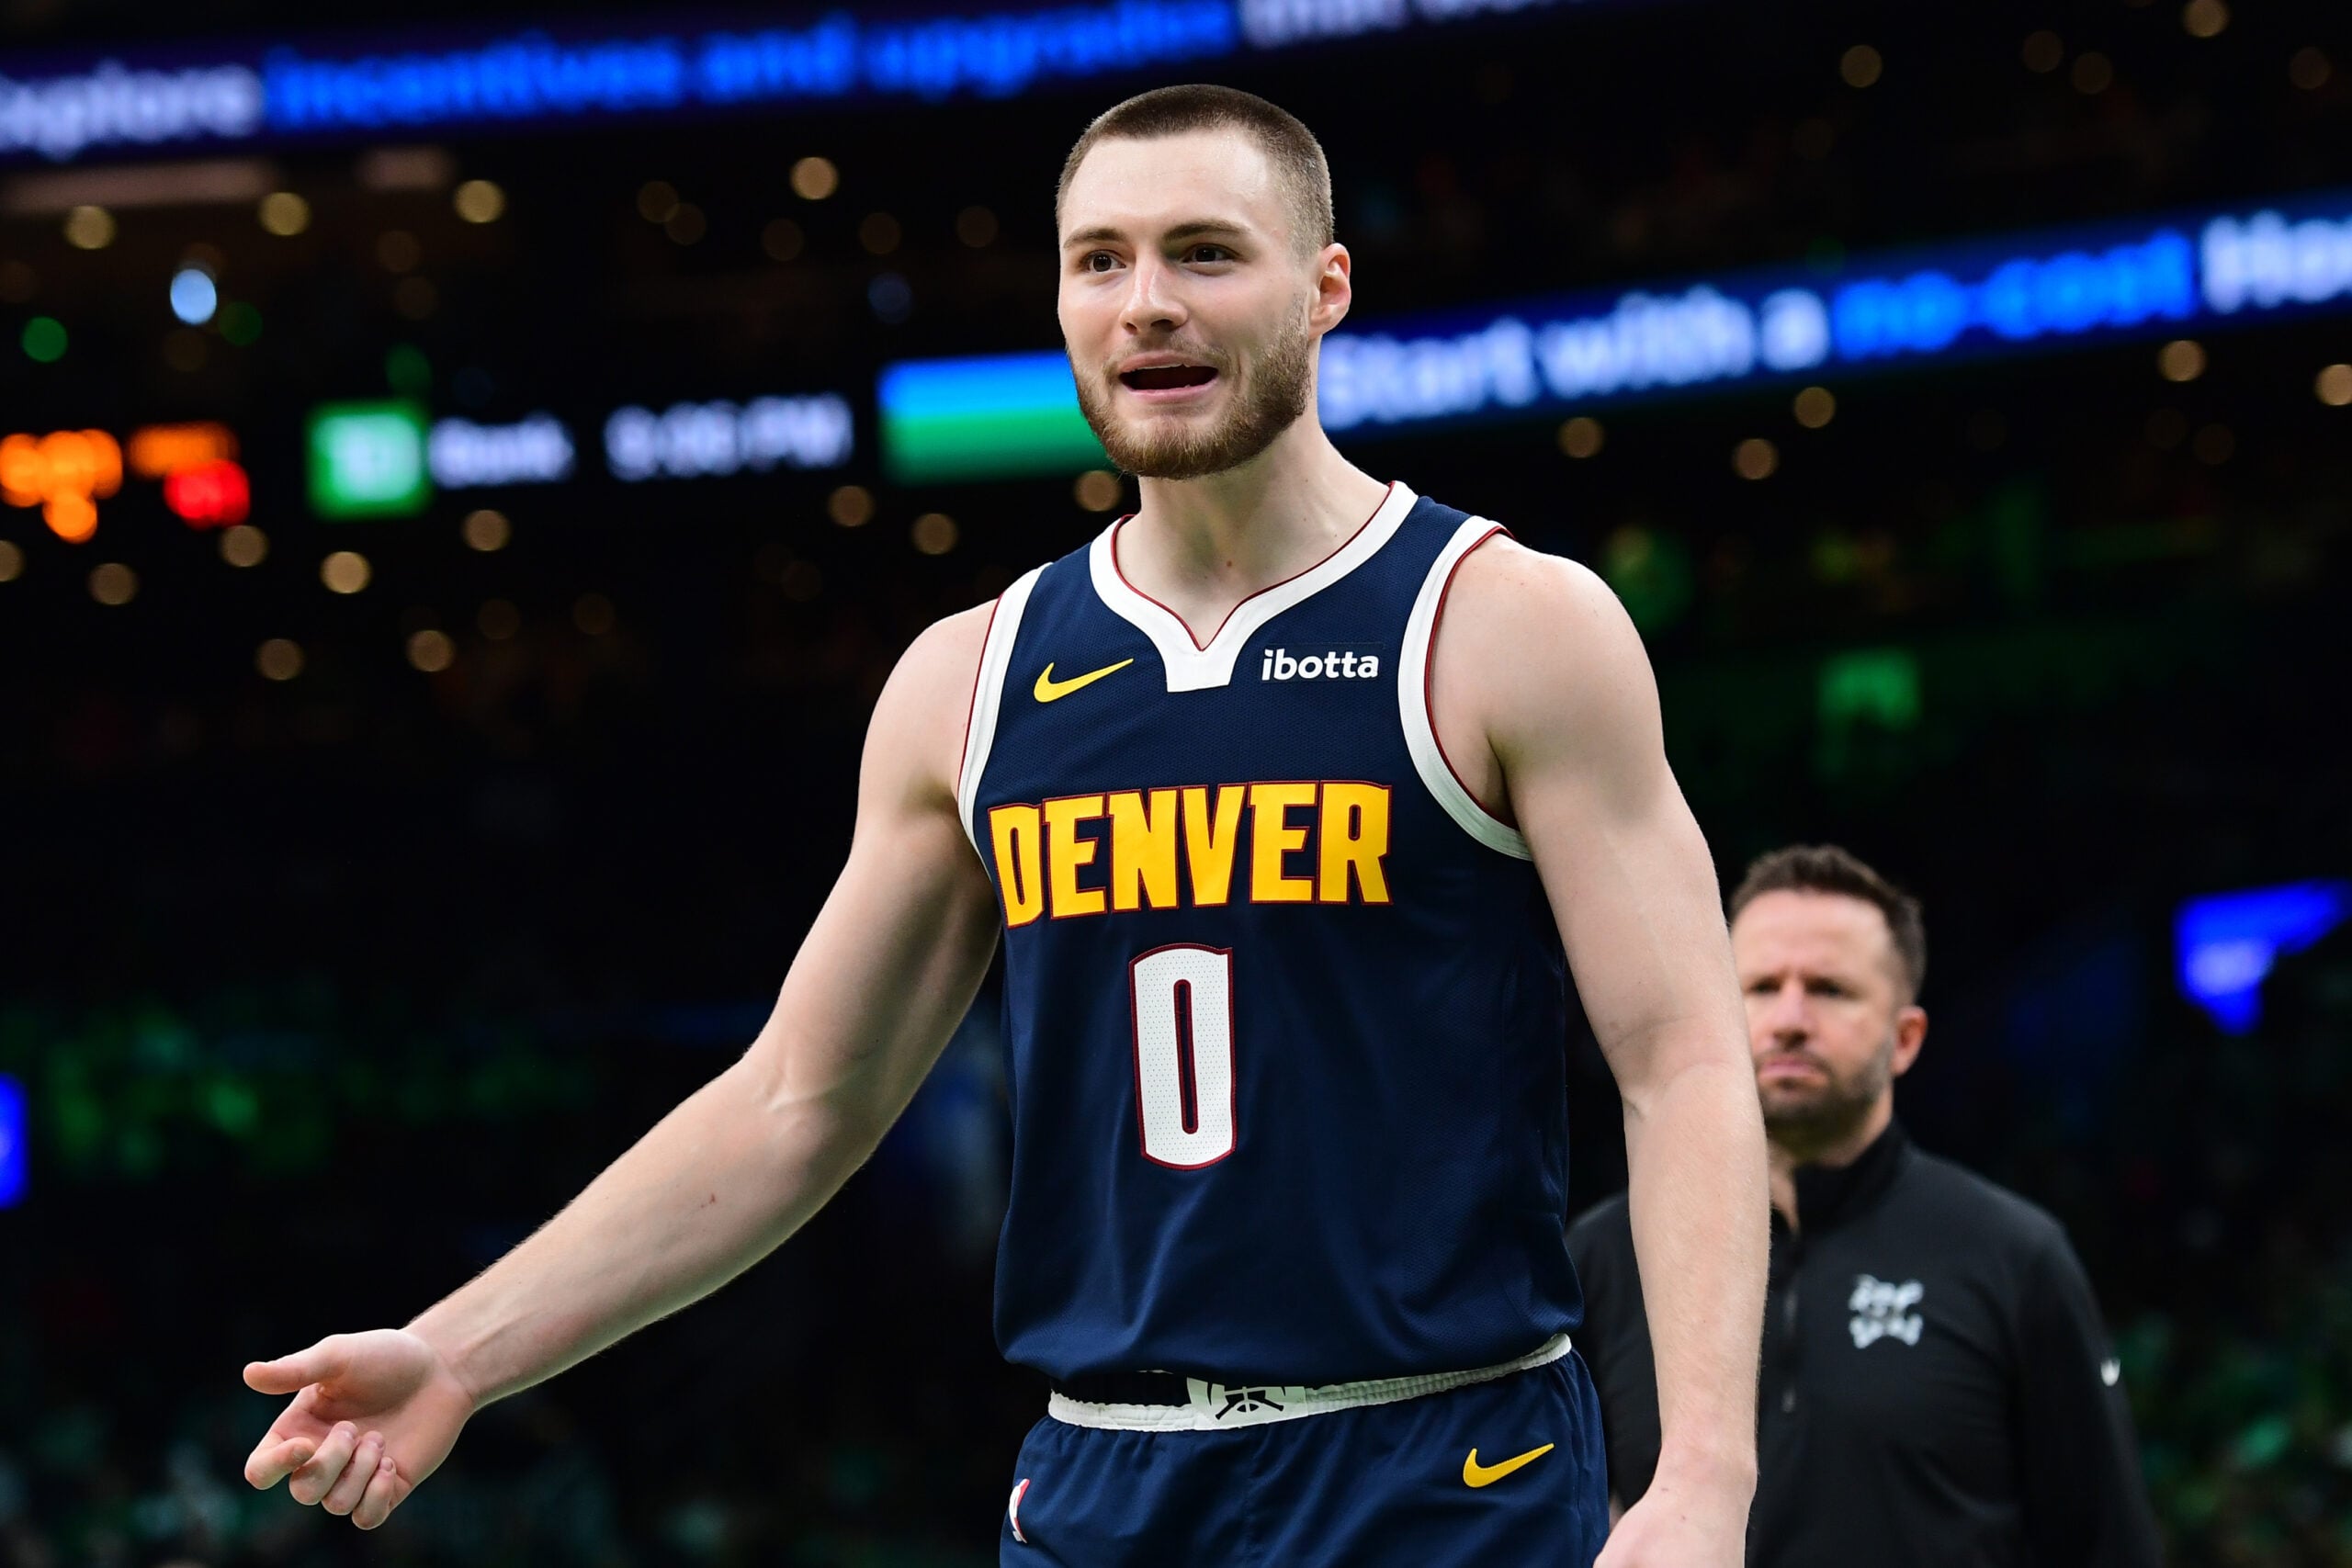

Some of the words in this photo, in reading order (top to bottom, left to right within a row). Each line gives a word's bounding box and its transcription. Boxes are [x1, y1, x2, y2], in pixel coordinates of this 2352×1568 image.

[0, 66, 261, 153] xplore
[698, 29, 854, 103] and
[1538, 287, 1755, 395] with
[1261, 648, 1379, 681] ibotta
[989, 781, 1393, 929] DENVER
[1129, 942, 1237, 1170] 0
